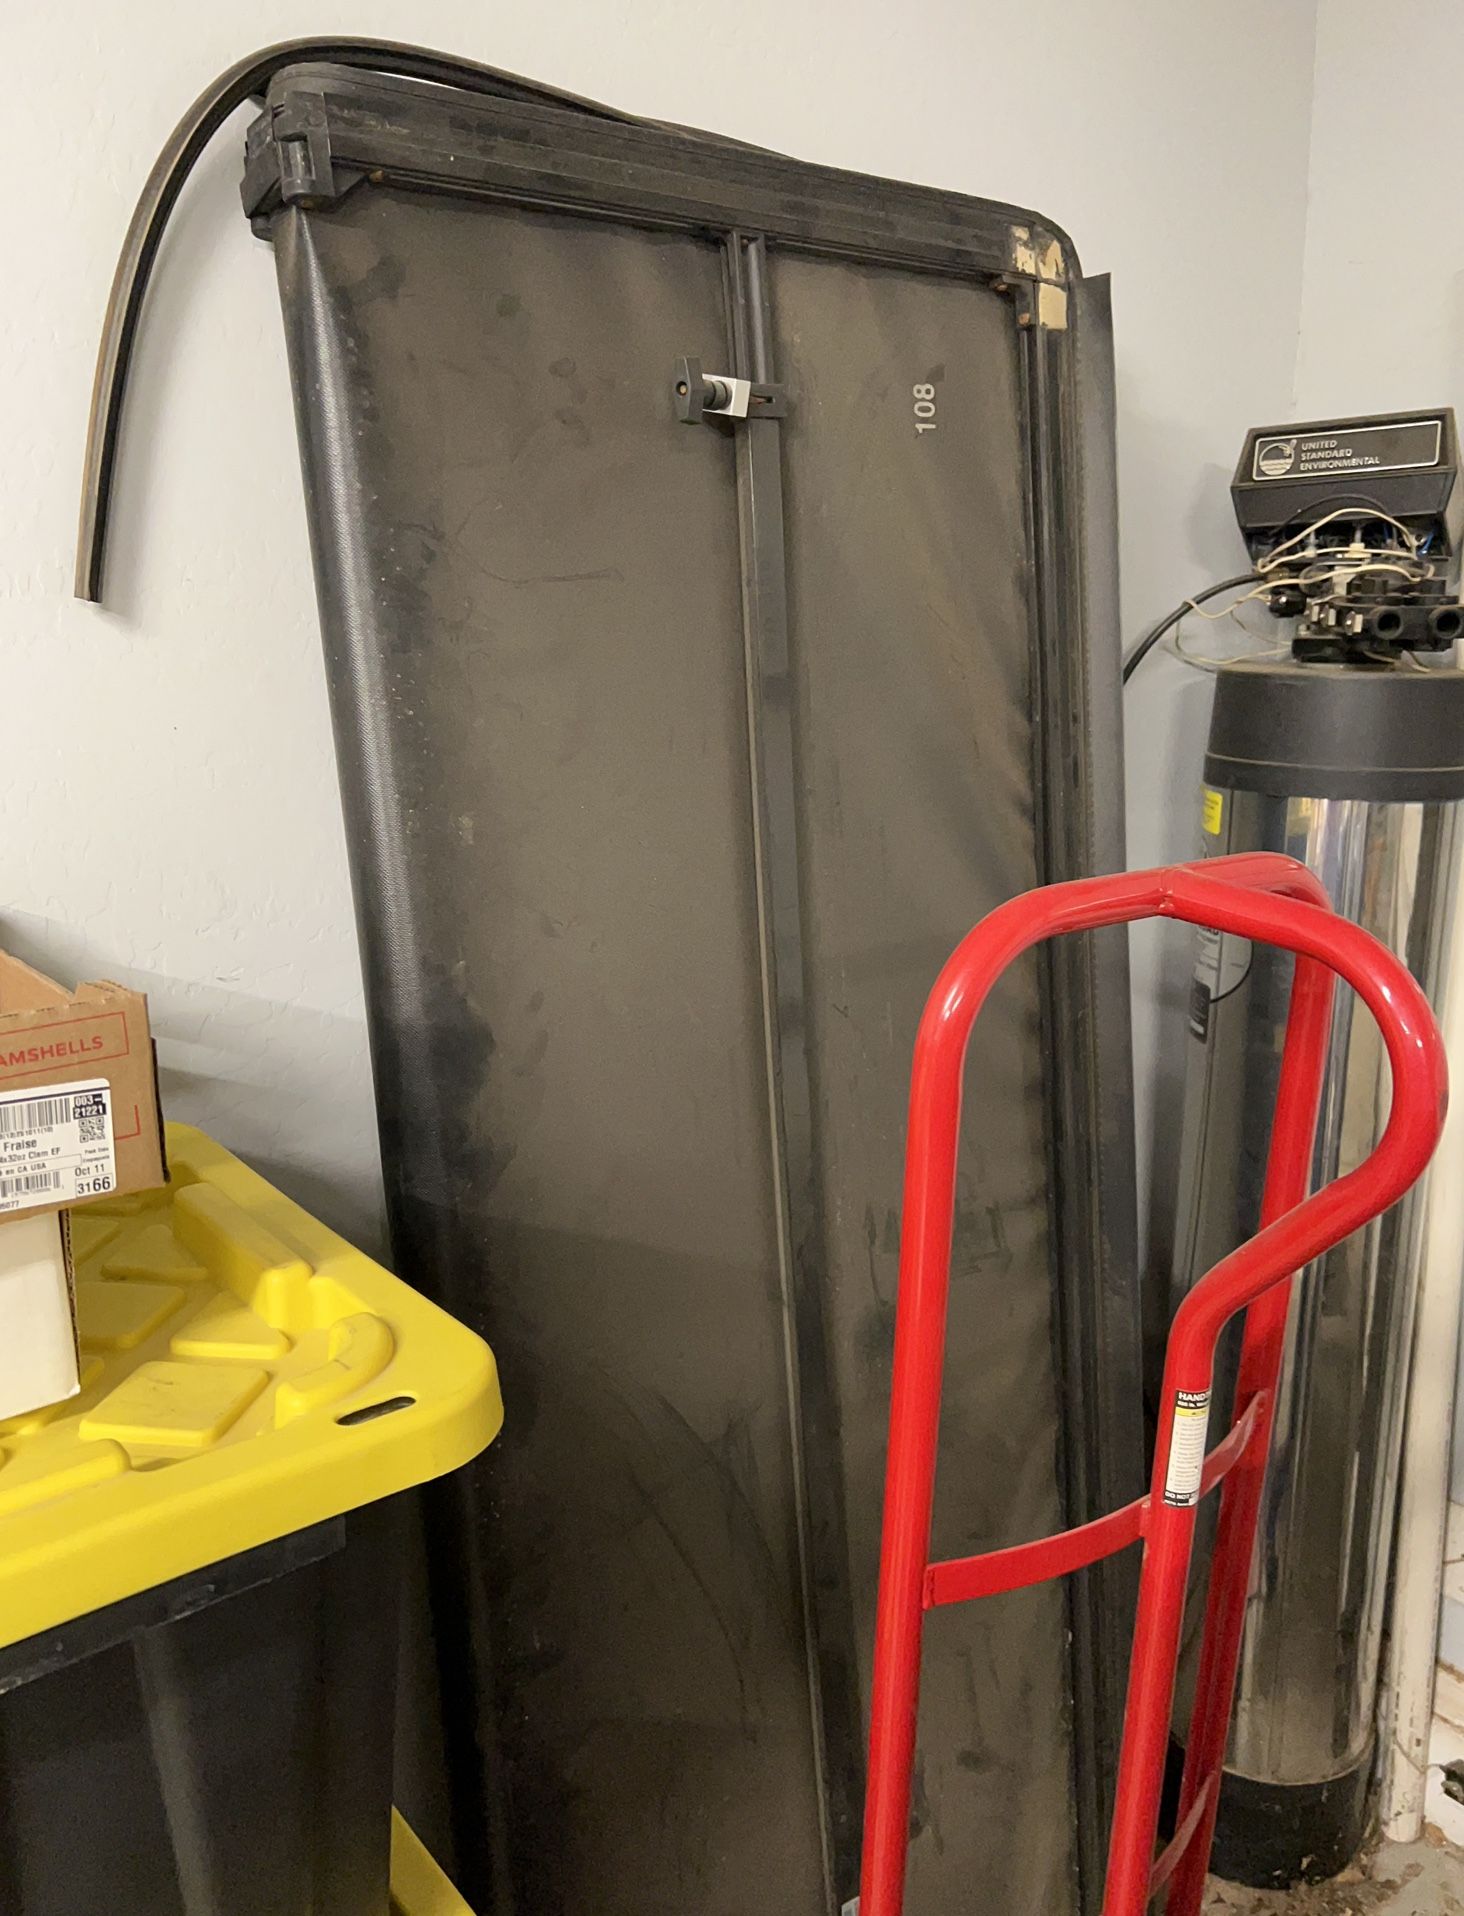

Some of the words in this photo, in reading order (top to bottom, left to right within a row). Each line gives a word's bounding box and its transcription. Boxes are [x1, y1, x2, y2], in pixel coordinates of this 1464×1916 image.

[913, 383, 936, 433] 108
[1302, 440, 1338, 450] UNITED
[1301, 448, 1353, 461] STANDARD
[1300, 456, 1381, 471] ENVIRONMENTAL
[74, 1105, 104, 1118] 21221
[3, 1139, 37, 1152] Fraise
[30, 1162, 47, 1171] USA
[75, 1167, 91, 1177] Oct
[95, 1163, 105, 1173] 11
[78, 1177, 111, 1194] 3166
